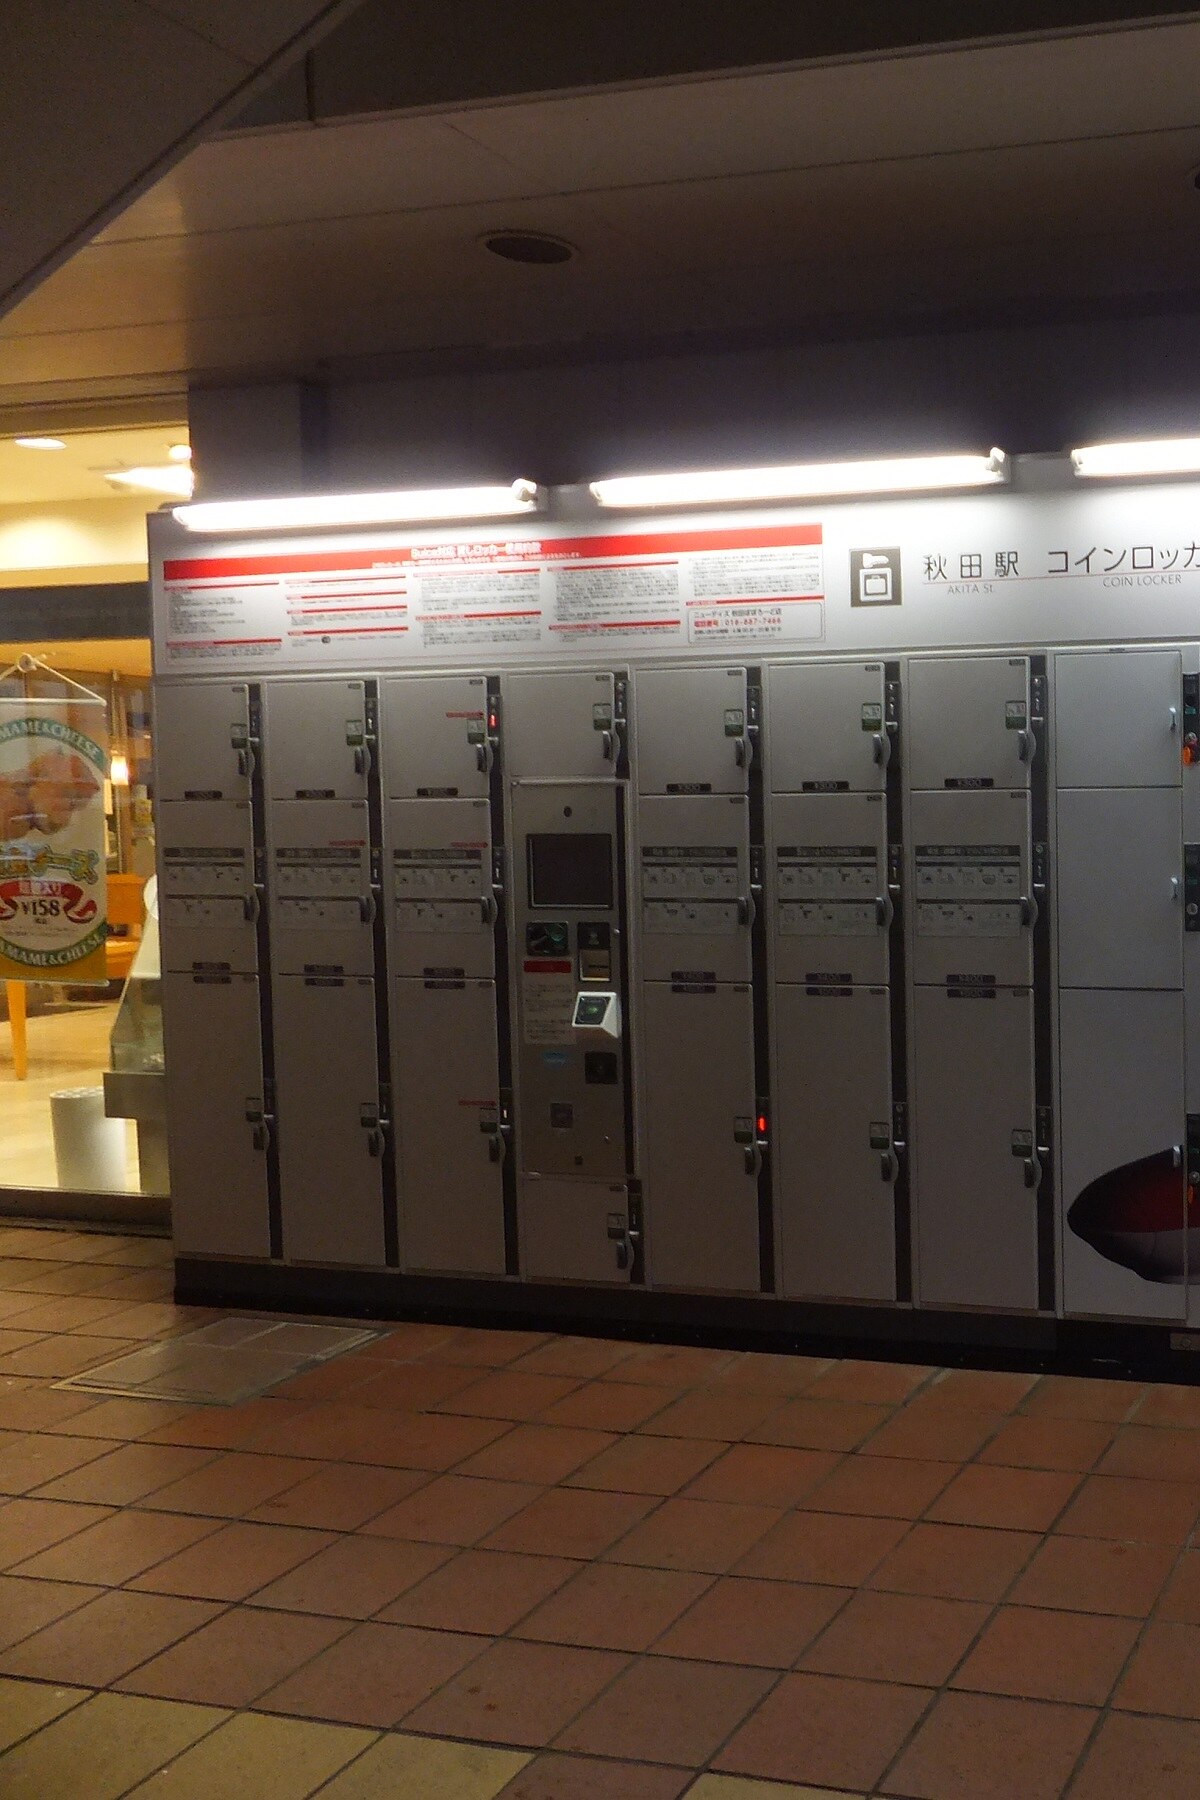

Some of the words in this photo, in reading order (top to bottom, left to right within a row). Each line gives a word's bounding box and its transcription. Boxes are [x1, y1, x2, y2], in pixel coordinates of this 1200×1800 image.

[923, 550, 1019, 582] 秋田駅
[1102, 575, 1133, 588] COIN
[1137, 573, 1182, 587] LOCKER
[947, 583, 980, 595] AKITA
